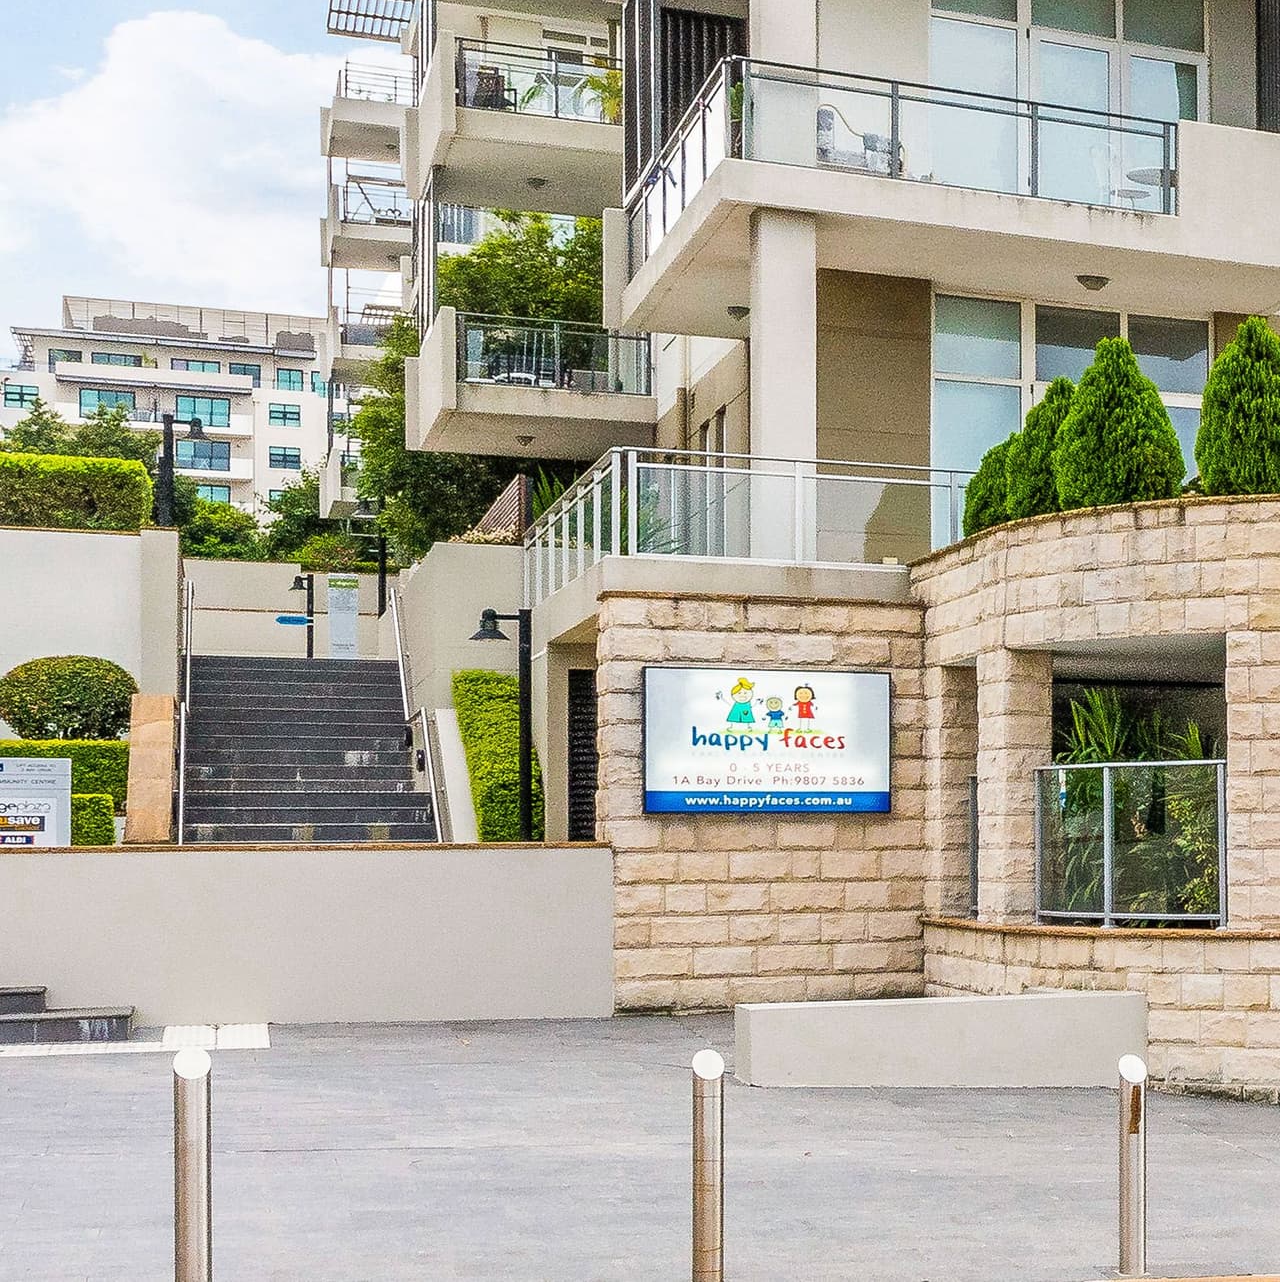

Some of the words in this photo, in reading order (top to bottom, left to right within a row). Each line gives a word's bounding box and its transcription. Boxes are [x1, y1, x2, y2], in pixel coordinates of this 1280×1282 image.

[691, 726, 769, 751] happy
[779, 728, 846, 749] faces
[766, 762, 810, 773] YEARS
[673, 775, 690, 786] 1A
[696, 775, 720, 789] Bay
[726, 775, 763, 786] Drive
[832, 776, 865, 787] 5836
[684, 794, 853, 808] www.happyfaces.com.au
